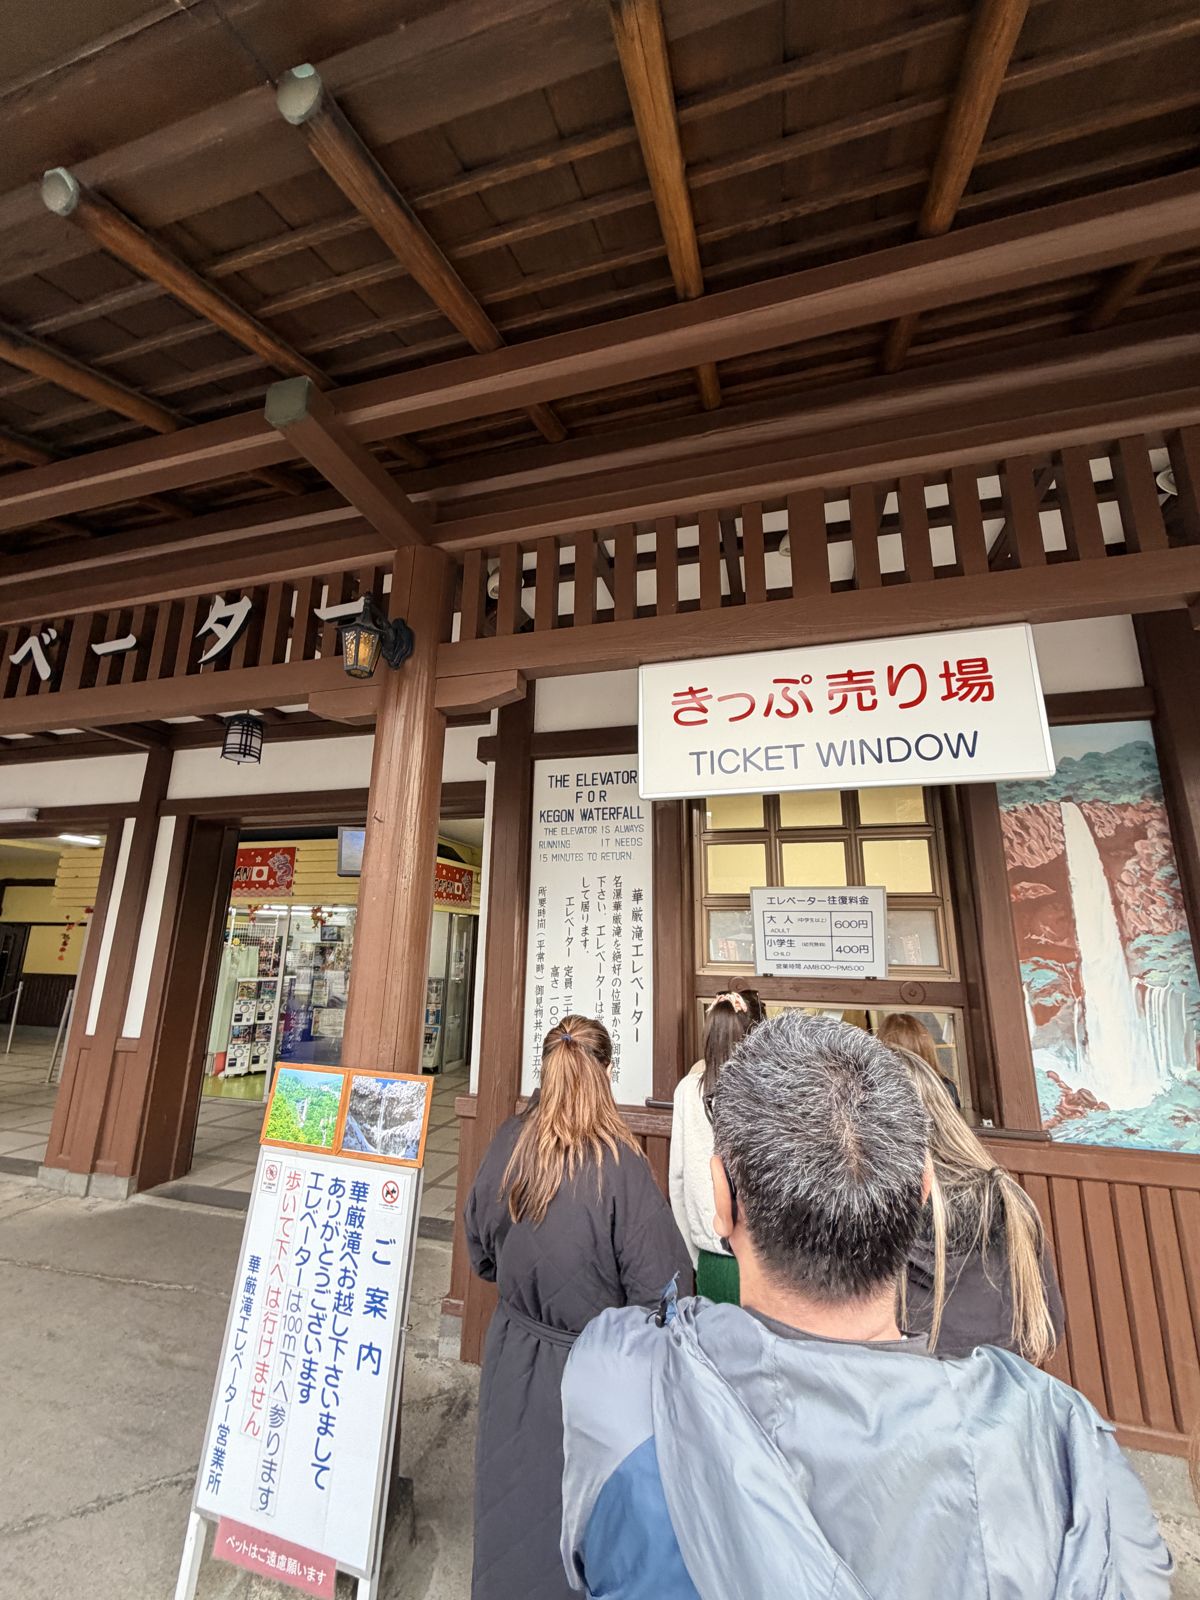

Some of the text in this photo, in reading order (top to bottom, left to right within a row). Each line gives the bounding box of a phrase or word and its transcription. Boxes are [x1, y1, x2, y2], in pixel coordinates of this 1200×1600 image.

[671, 657, 995, 727] きっぷ売り場
[688, 730, 979, 776] TICKET WINDOW
[547, 770, 638, 789] THE ELEVATOR
[575, 790, 608, 804] FOR
[539, 805, 645, 823] KEGON WATERFALL
[544, 824, 645, 836] THE ELEVATOR IS ALWAYS
[538, 837, 643, 849] RUNNING IT NEEDS
[539, 851, 632, 863] 15 MINUTES TO RETURN
[766, 895, 870, 906] エレベーター往復料金
[834, 919, 869, 929] 600円
[767, 938, 796, 948] 小学生
[835, 944, 870, 955] 400円
[630, 888, 645, 1043] 華厳滝エレベーター
[297, 1176, 347, 1404] ありがとうございます
[243, 1171, 302, 1437] 歩いて下へは行けません
[258, 1171, 325, 1511] エレベーターは100m下へ参ります
[310, 1180, 371, 1491] 華厳滝へお越し下さいまして
[205, 1254, 262, 1496] 華厳滝エレベーター営業所
[225, 1535, 327, 1586] ペットはご遠慮願います
